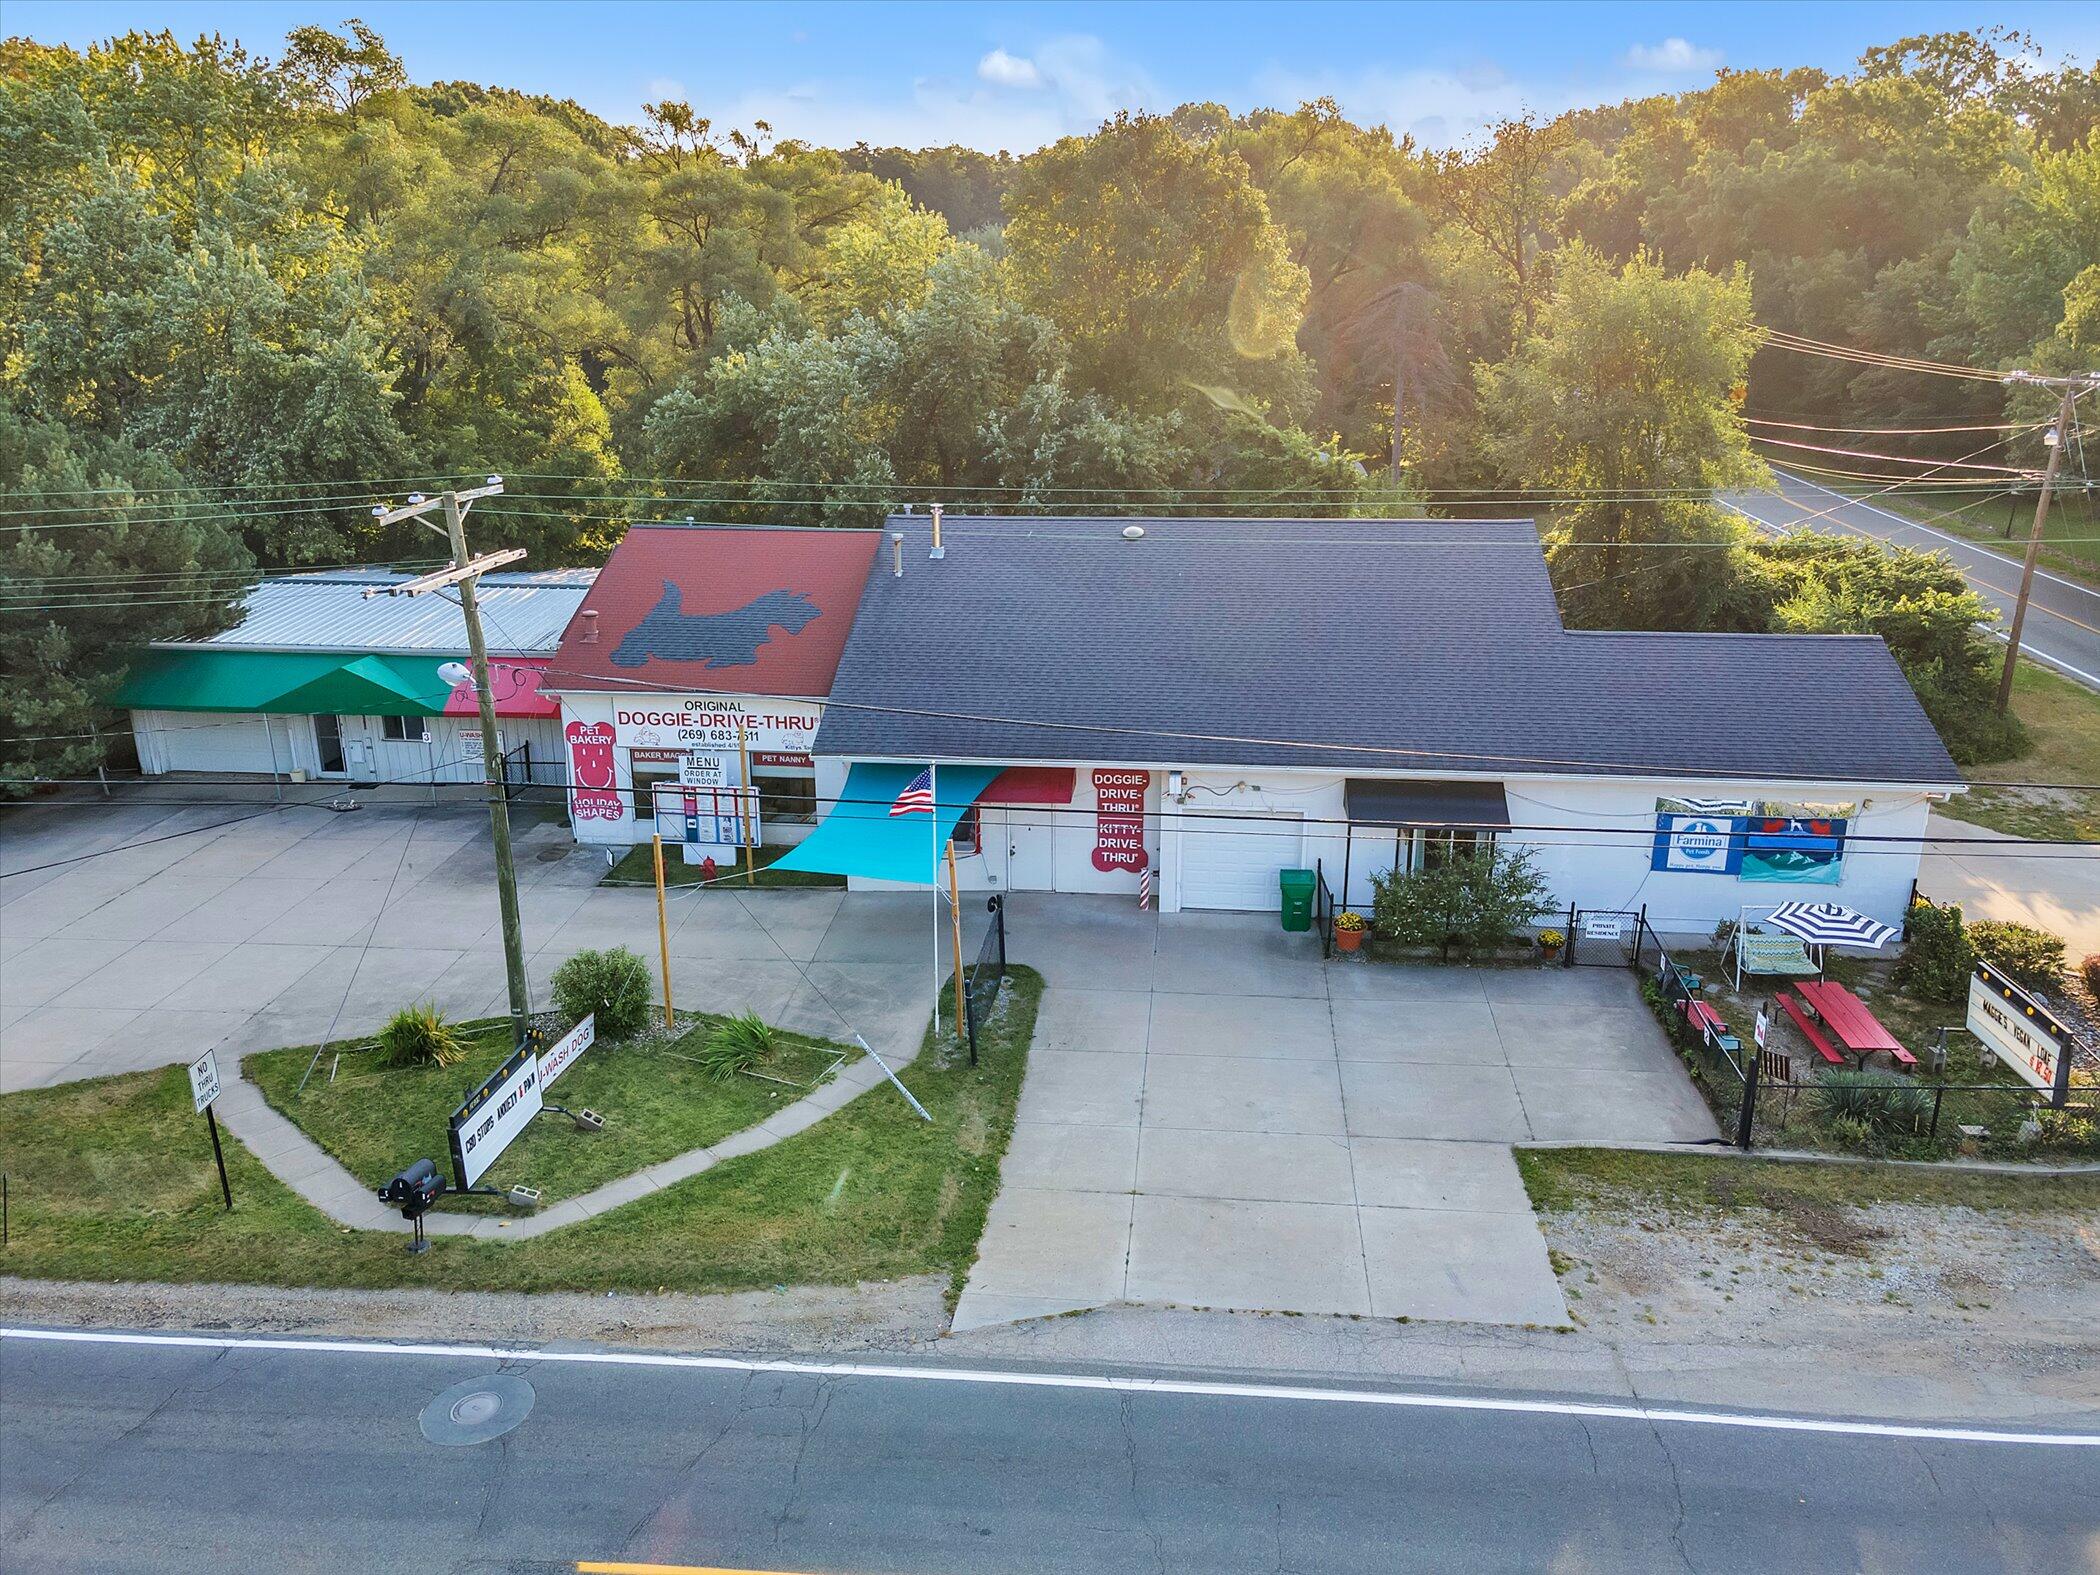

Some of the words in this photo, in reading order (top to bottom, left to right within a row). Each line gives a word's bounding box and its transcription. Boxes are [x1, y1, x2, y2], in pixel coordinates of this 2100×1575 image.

[684, 701, 745, 712] ORIGINAL
[580, 726, 600, 735] PET
[678, 729, 706, 742] (269)
[423, 733, 429, 742] 3
[570, 735, 613, 745] BAKERY
[634, 751, 661, 759] BAKER
[686, 757, 720, 767] MENU
[1094, 774, 1147, 785] DOGGIE-
[1100, 789, 1142, 799] DRIVE-
[574, 798, 621, 810] HOLIDAY
[576, 808, 620, 820] SHAPES
[1100, 823, 1141, 835] KITTY-
[1099, 838, 1142, 849] DRIVE-
[1676, 835, 1722, 846] Farmina
[2013, 1022, 2032, 1050] VEGAN
[197, 1061, 208, 1077] NO
[197, 1072, 214, 1092] THRU
[196, 1082, 219, 1107] TRUCKS
[465, 1133, 477, 1154] CBD
[476, 1115, 495, 1142] STOPS
[496, 1090, 518, 1121] ANXIETY
[523, 1072, 536, 1094] PAIN
